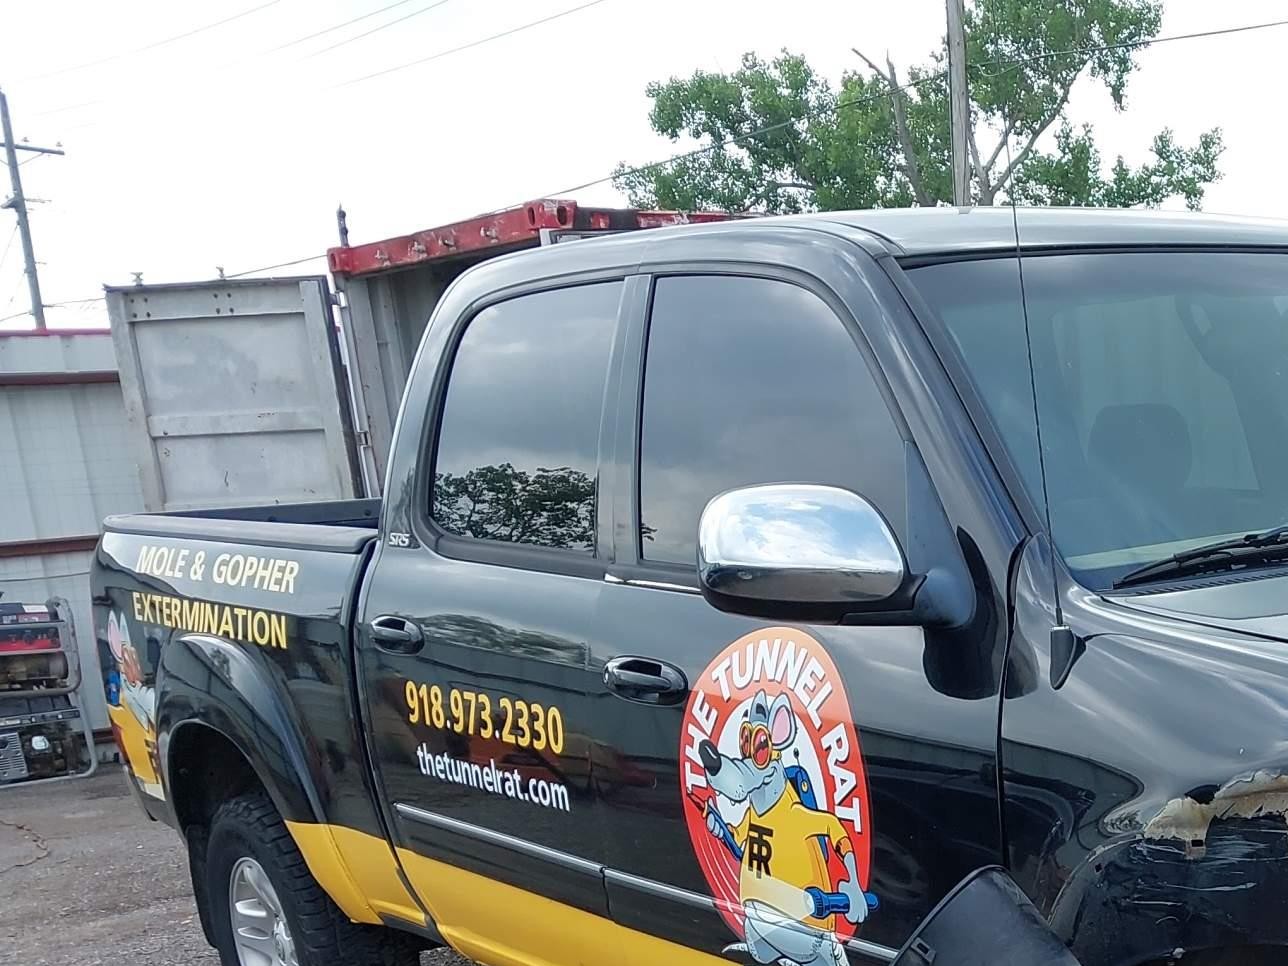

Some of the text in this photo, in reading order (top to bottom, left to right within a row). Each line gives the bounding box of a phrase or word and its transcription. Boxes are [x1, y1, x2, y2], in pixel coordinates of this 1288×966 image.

[136, 544, 300, 595] MOLE & GOPHER
[388, 532, 411, 548] SR5
[132, 591, 288, 650] EXTERMINATION
[404, 679, 565, 755] 918.973.2330
[684, 638, 863, 834] THE TUNNEL RAT
[415, 742, 571, 813] thetunnelrat.com
